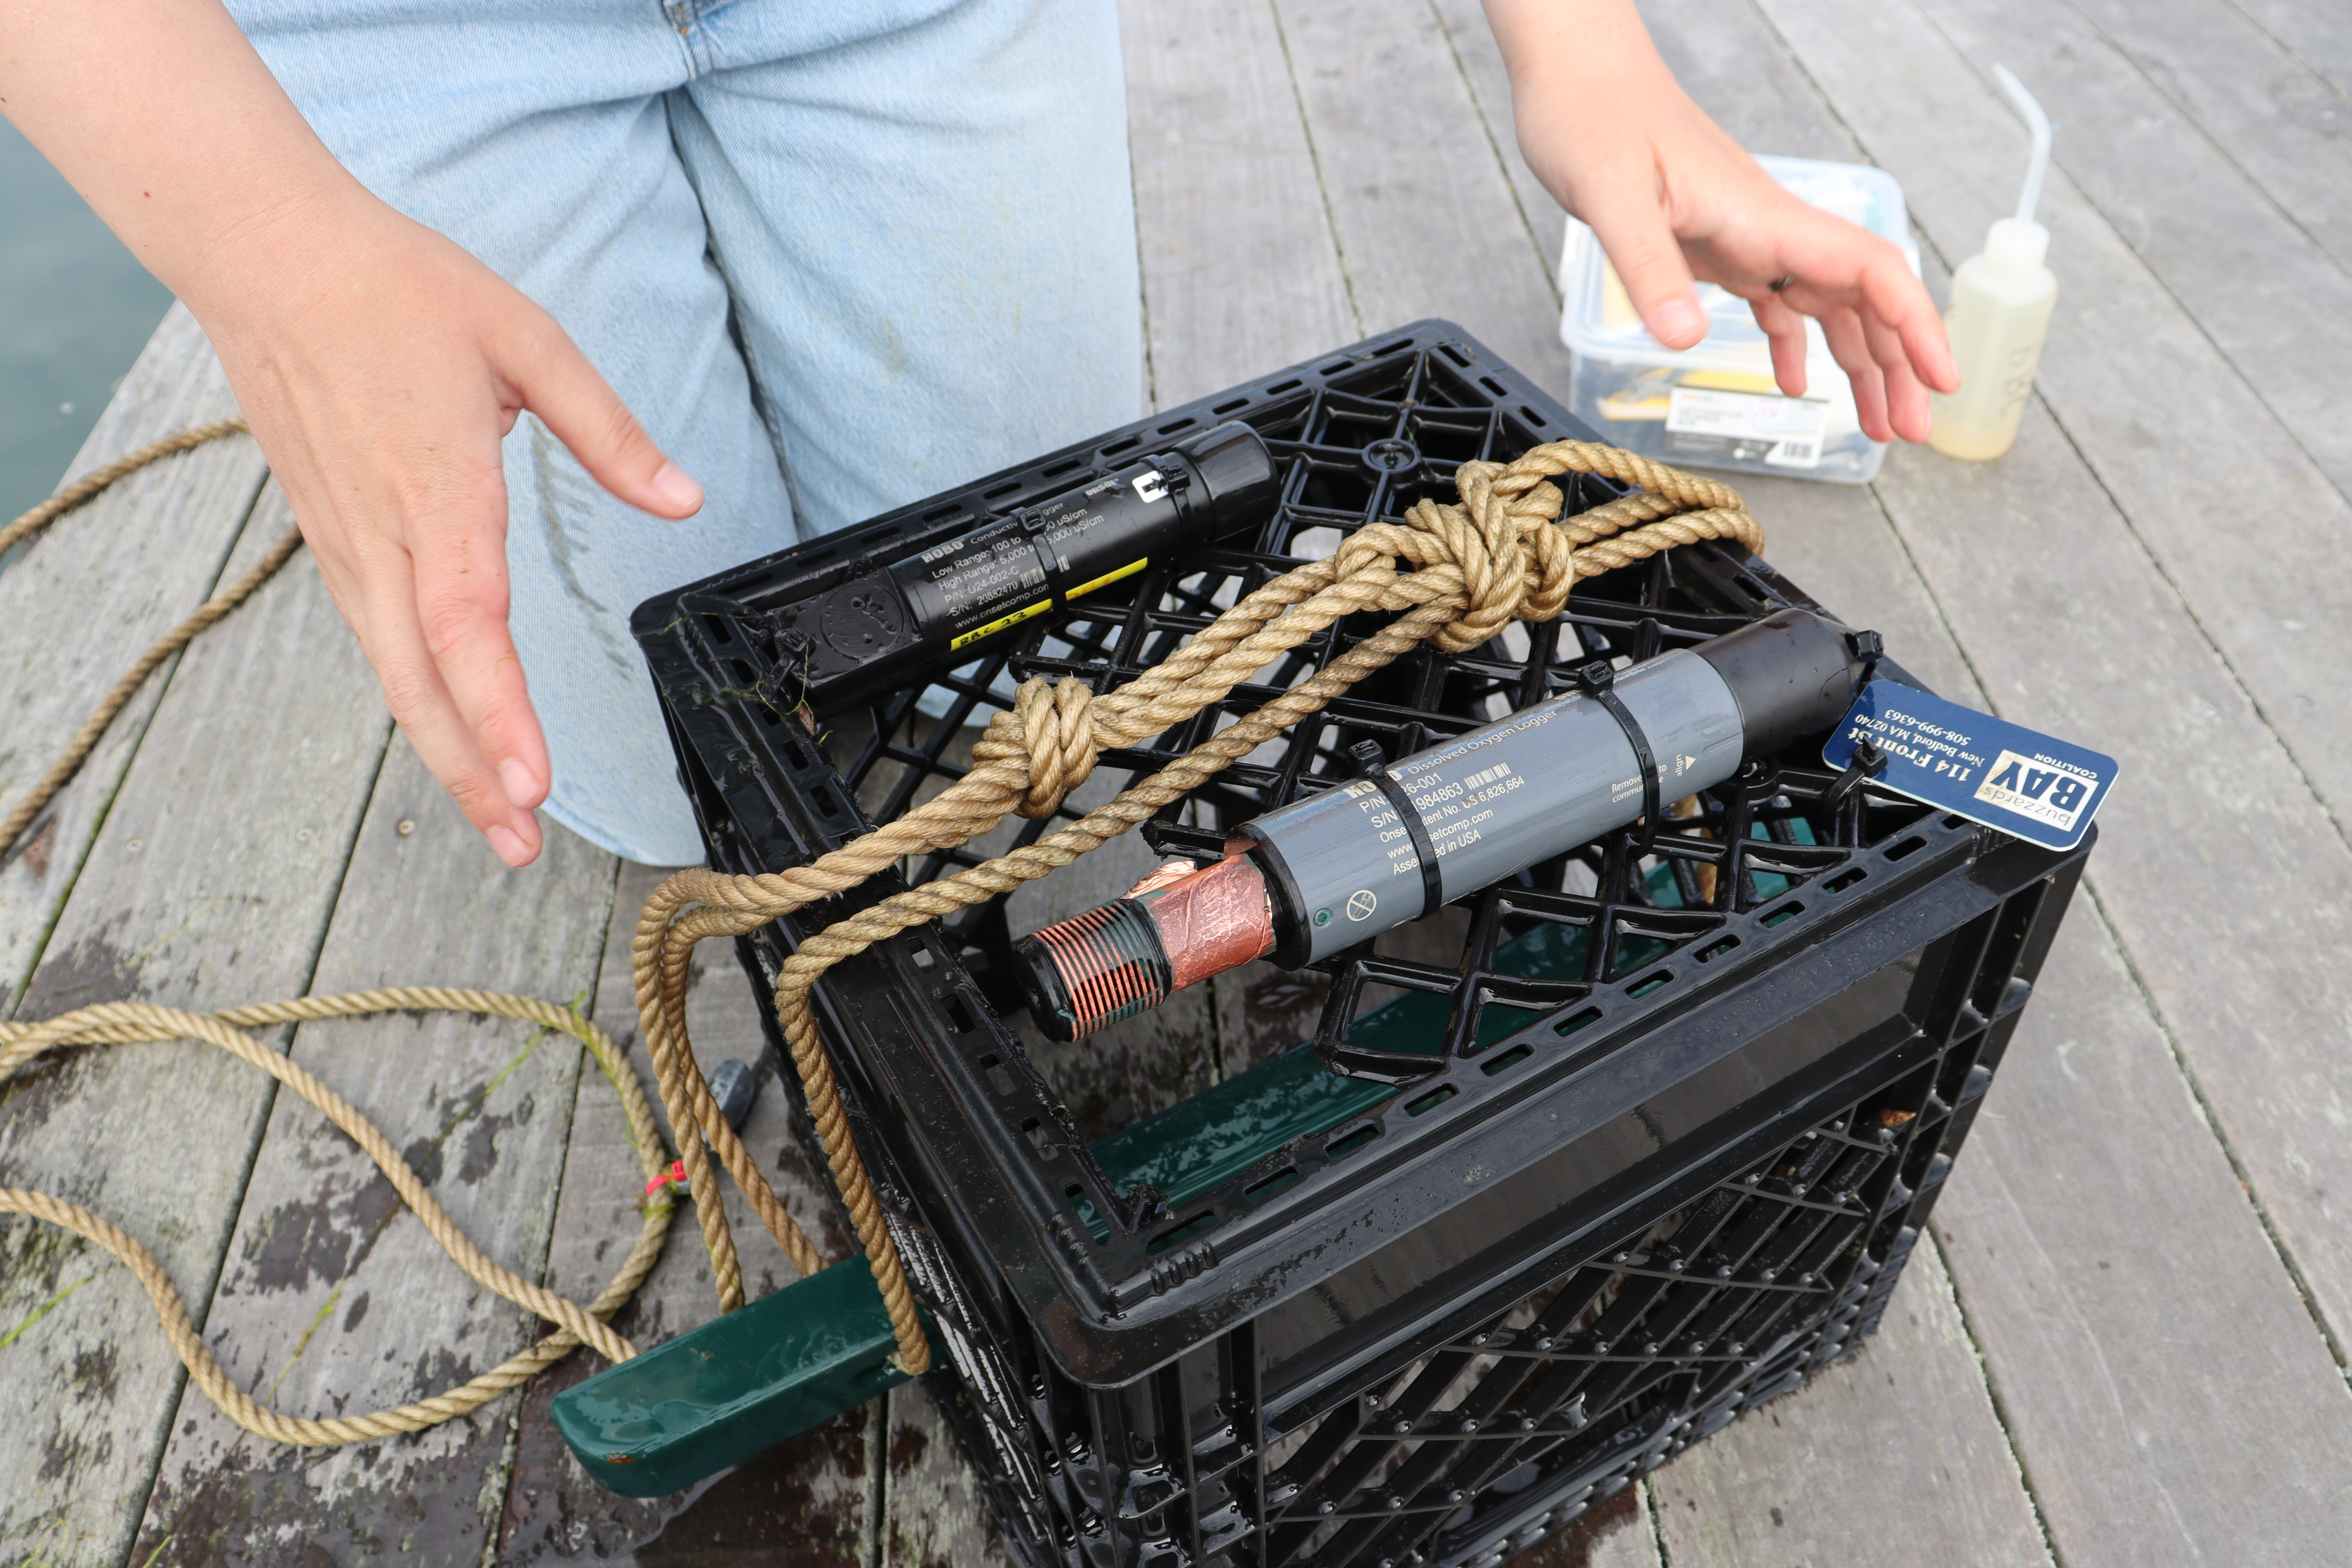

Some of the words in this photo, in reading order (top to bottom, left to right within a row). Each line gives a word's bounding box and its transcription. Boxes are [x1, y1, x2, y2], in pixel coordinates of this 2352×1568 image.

[920, 540, 964, 563] HOBO
[970, 522, 1018, 544] Conductiv
[1043, 502, 1064, 516] gger
[931, 566, 953, 579] Low
[954, 550, 990, 570] Range:
[991, 540, 1009, 553] 100
[1010, 536, 1022, 546] to
[1056, 508, 1088, 525] uS/cm
[937, 575, 962, 591] High
[962, 561, 998, 581] Range:
[999, 546, 1027, 565] 5,000
[1047, 527, 1072, 545] 5,000
[1073, 515, 1104, 532] uS/cm
[944, 591, 966, 604] P/N:
[967, 566, 1019, 594] U24-002-C
[949, 603, 973, 617] S/N:
[976, 581, 1018, 606] 20882470
[1000, 612, 1027, 628] 23
[1847, 727, 1874, 745] St
[1855, 713, 1889, 732] 02740
[1884, 709, 1972, 746] 508-999-6363
[1889, 725, 1912, 740] MA
[1342, 769, 1403, 799] HOO
[1407, 746, 1468, 775] Dissolved
[1467, 728, 1516, 750] Oxygen
[1514, 710, 1557, 731] Logger
[1875, 736, 1935, 768] Front
[1912, 732, 1958, 758] Bedford,
[1957, 751, 1986, 768] New
[1612, 775, 1642, 793] Remove
[1658, 764, 1667, 773] to
[1675, 753, 1684, 777] align
[1934, 759, 1973, 782] 114
[2034, 753, 2098, 779] COALITION
[1358, 795, 1390, 813] P/N:
[1400, 772, 1443, 796] 26-001
[1989, 760, 2089, 813] BAY
[1379, 827, 1408, 843] Onse
[1421, 809, 1444, 826] tent
[1442, 802, 1461, 816] No.
[1462, 795, 1478, 809] US
[1479, 775, 1525, 802] 6,826,664
[1983, 786, 2071, 826] buzzards
[1393, 843, 1445, 876] Asseed
[1447, 840, 1457, 852] in
[1458, 829, 1482, 847] USA
